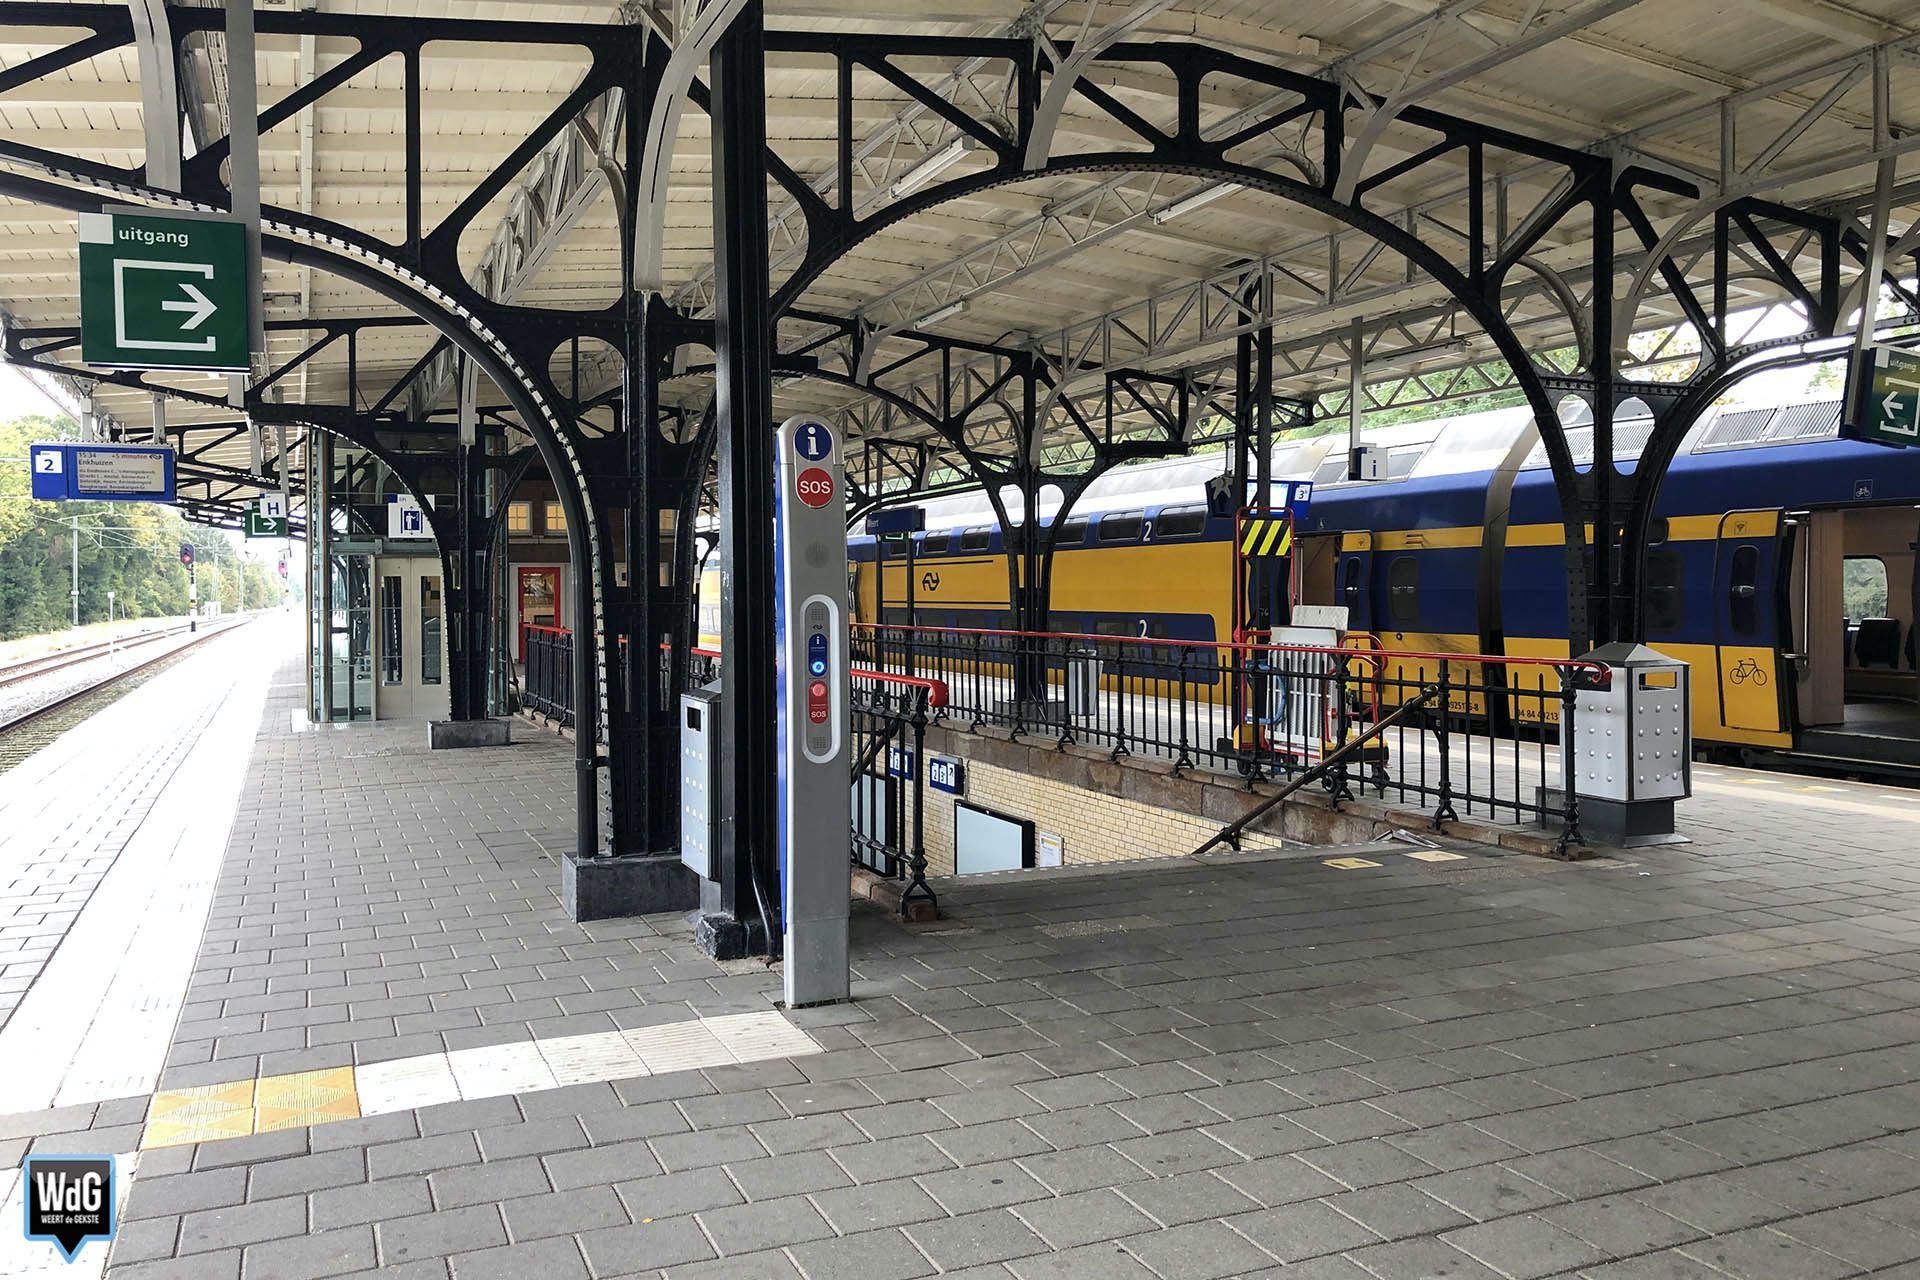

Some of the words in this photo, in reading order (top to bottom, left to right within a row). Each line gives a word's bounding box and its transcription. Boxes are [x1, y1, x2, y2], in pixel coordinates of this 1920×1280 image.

[119, 227, 188, 247] uitgang
[1889, 359, 1917, 373] uitgang
[44, 459, 54, 471] 2
[800, 480, 831, 495] SOS
[267, 502, 279, 515] H
[1143, 521, 1152, 541] 2
[916, 541, 920, 556] 1
[1139, 619, 1148, 639] 2
